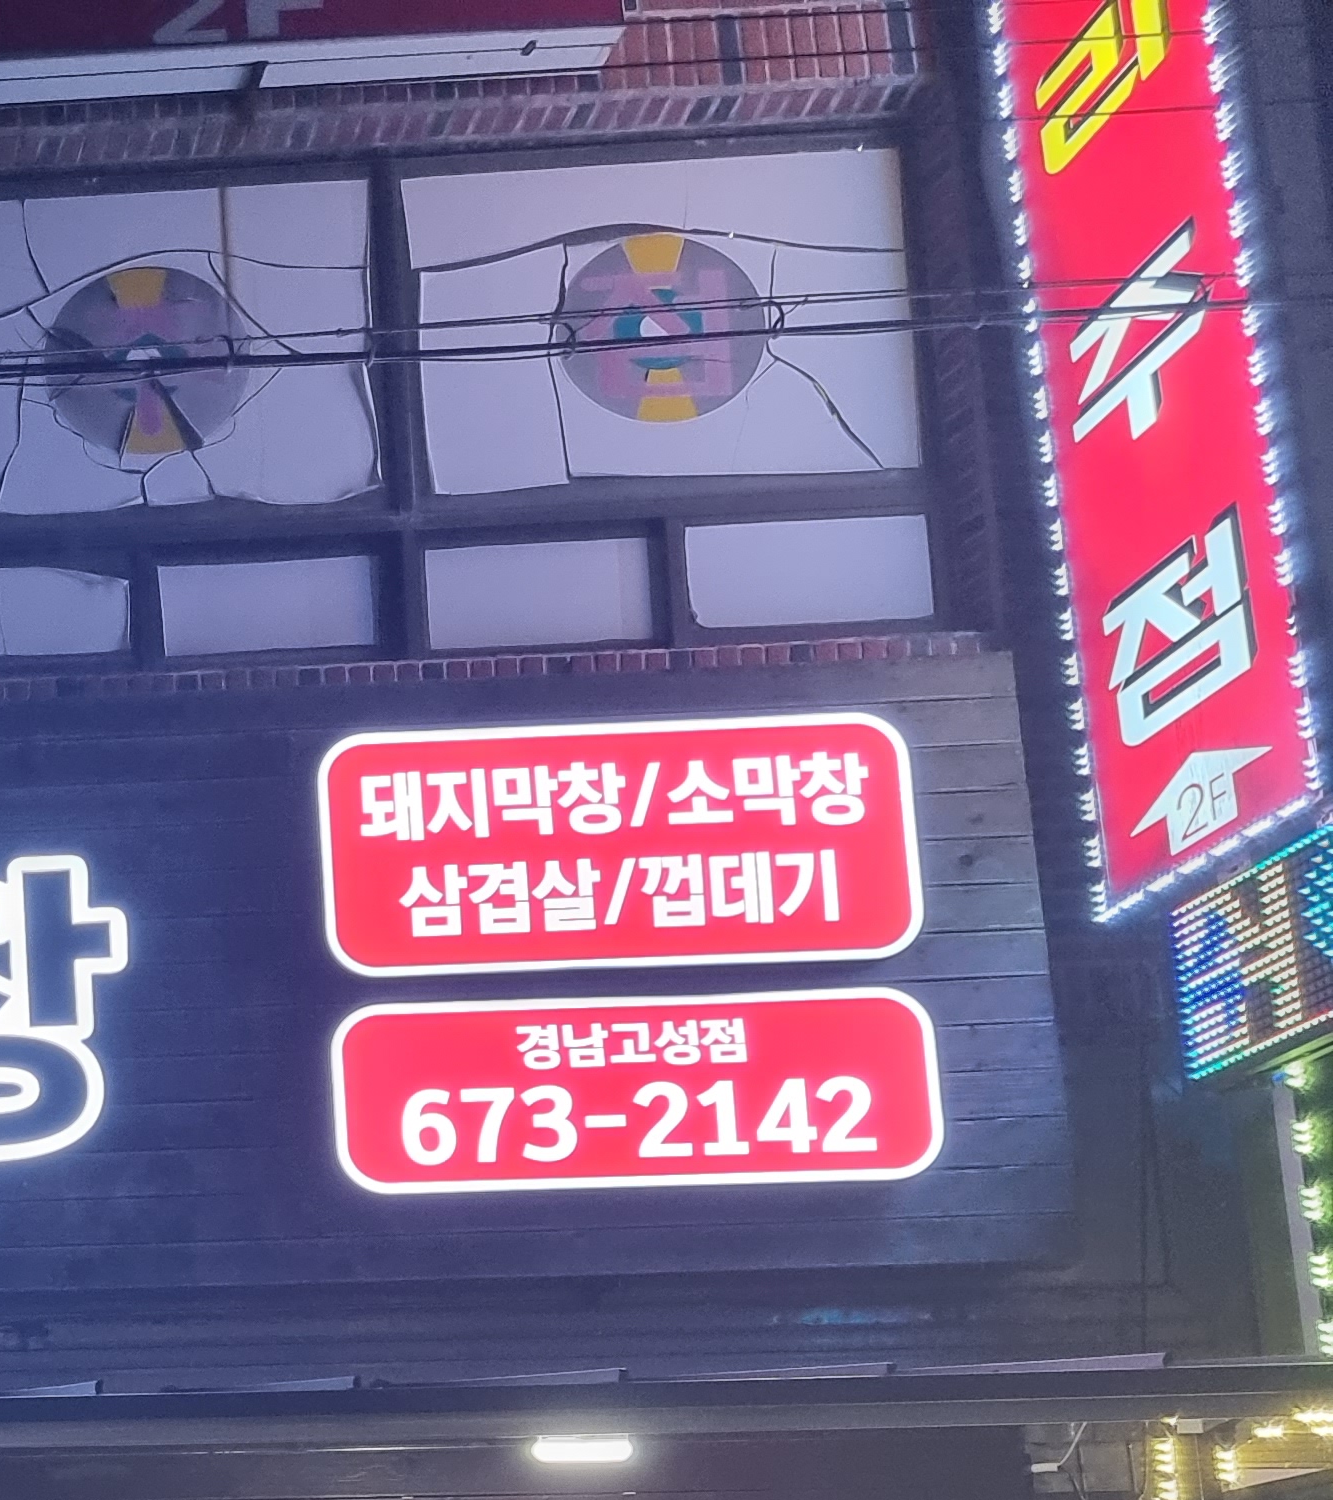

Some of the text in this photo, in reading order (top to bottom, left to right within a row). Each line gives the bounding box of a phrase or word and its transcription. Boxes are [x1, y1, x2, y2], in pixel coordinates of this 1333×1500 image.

[359, 751, 870, 842] 돼지막창/소막창
[1176, 781, 1227, 841] 2F
[399, 848, 841, 938] 삼겹살/껍데기
[514, 1017, 749, 1071] 경남고성점
[400, 1075, 879, 1167] 673-2142
